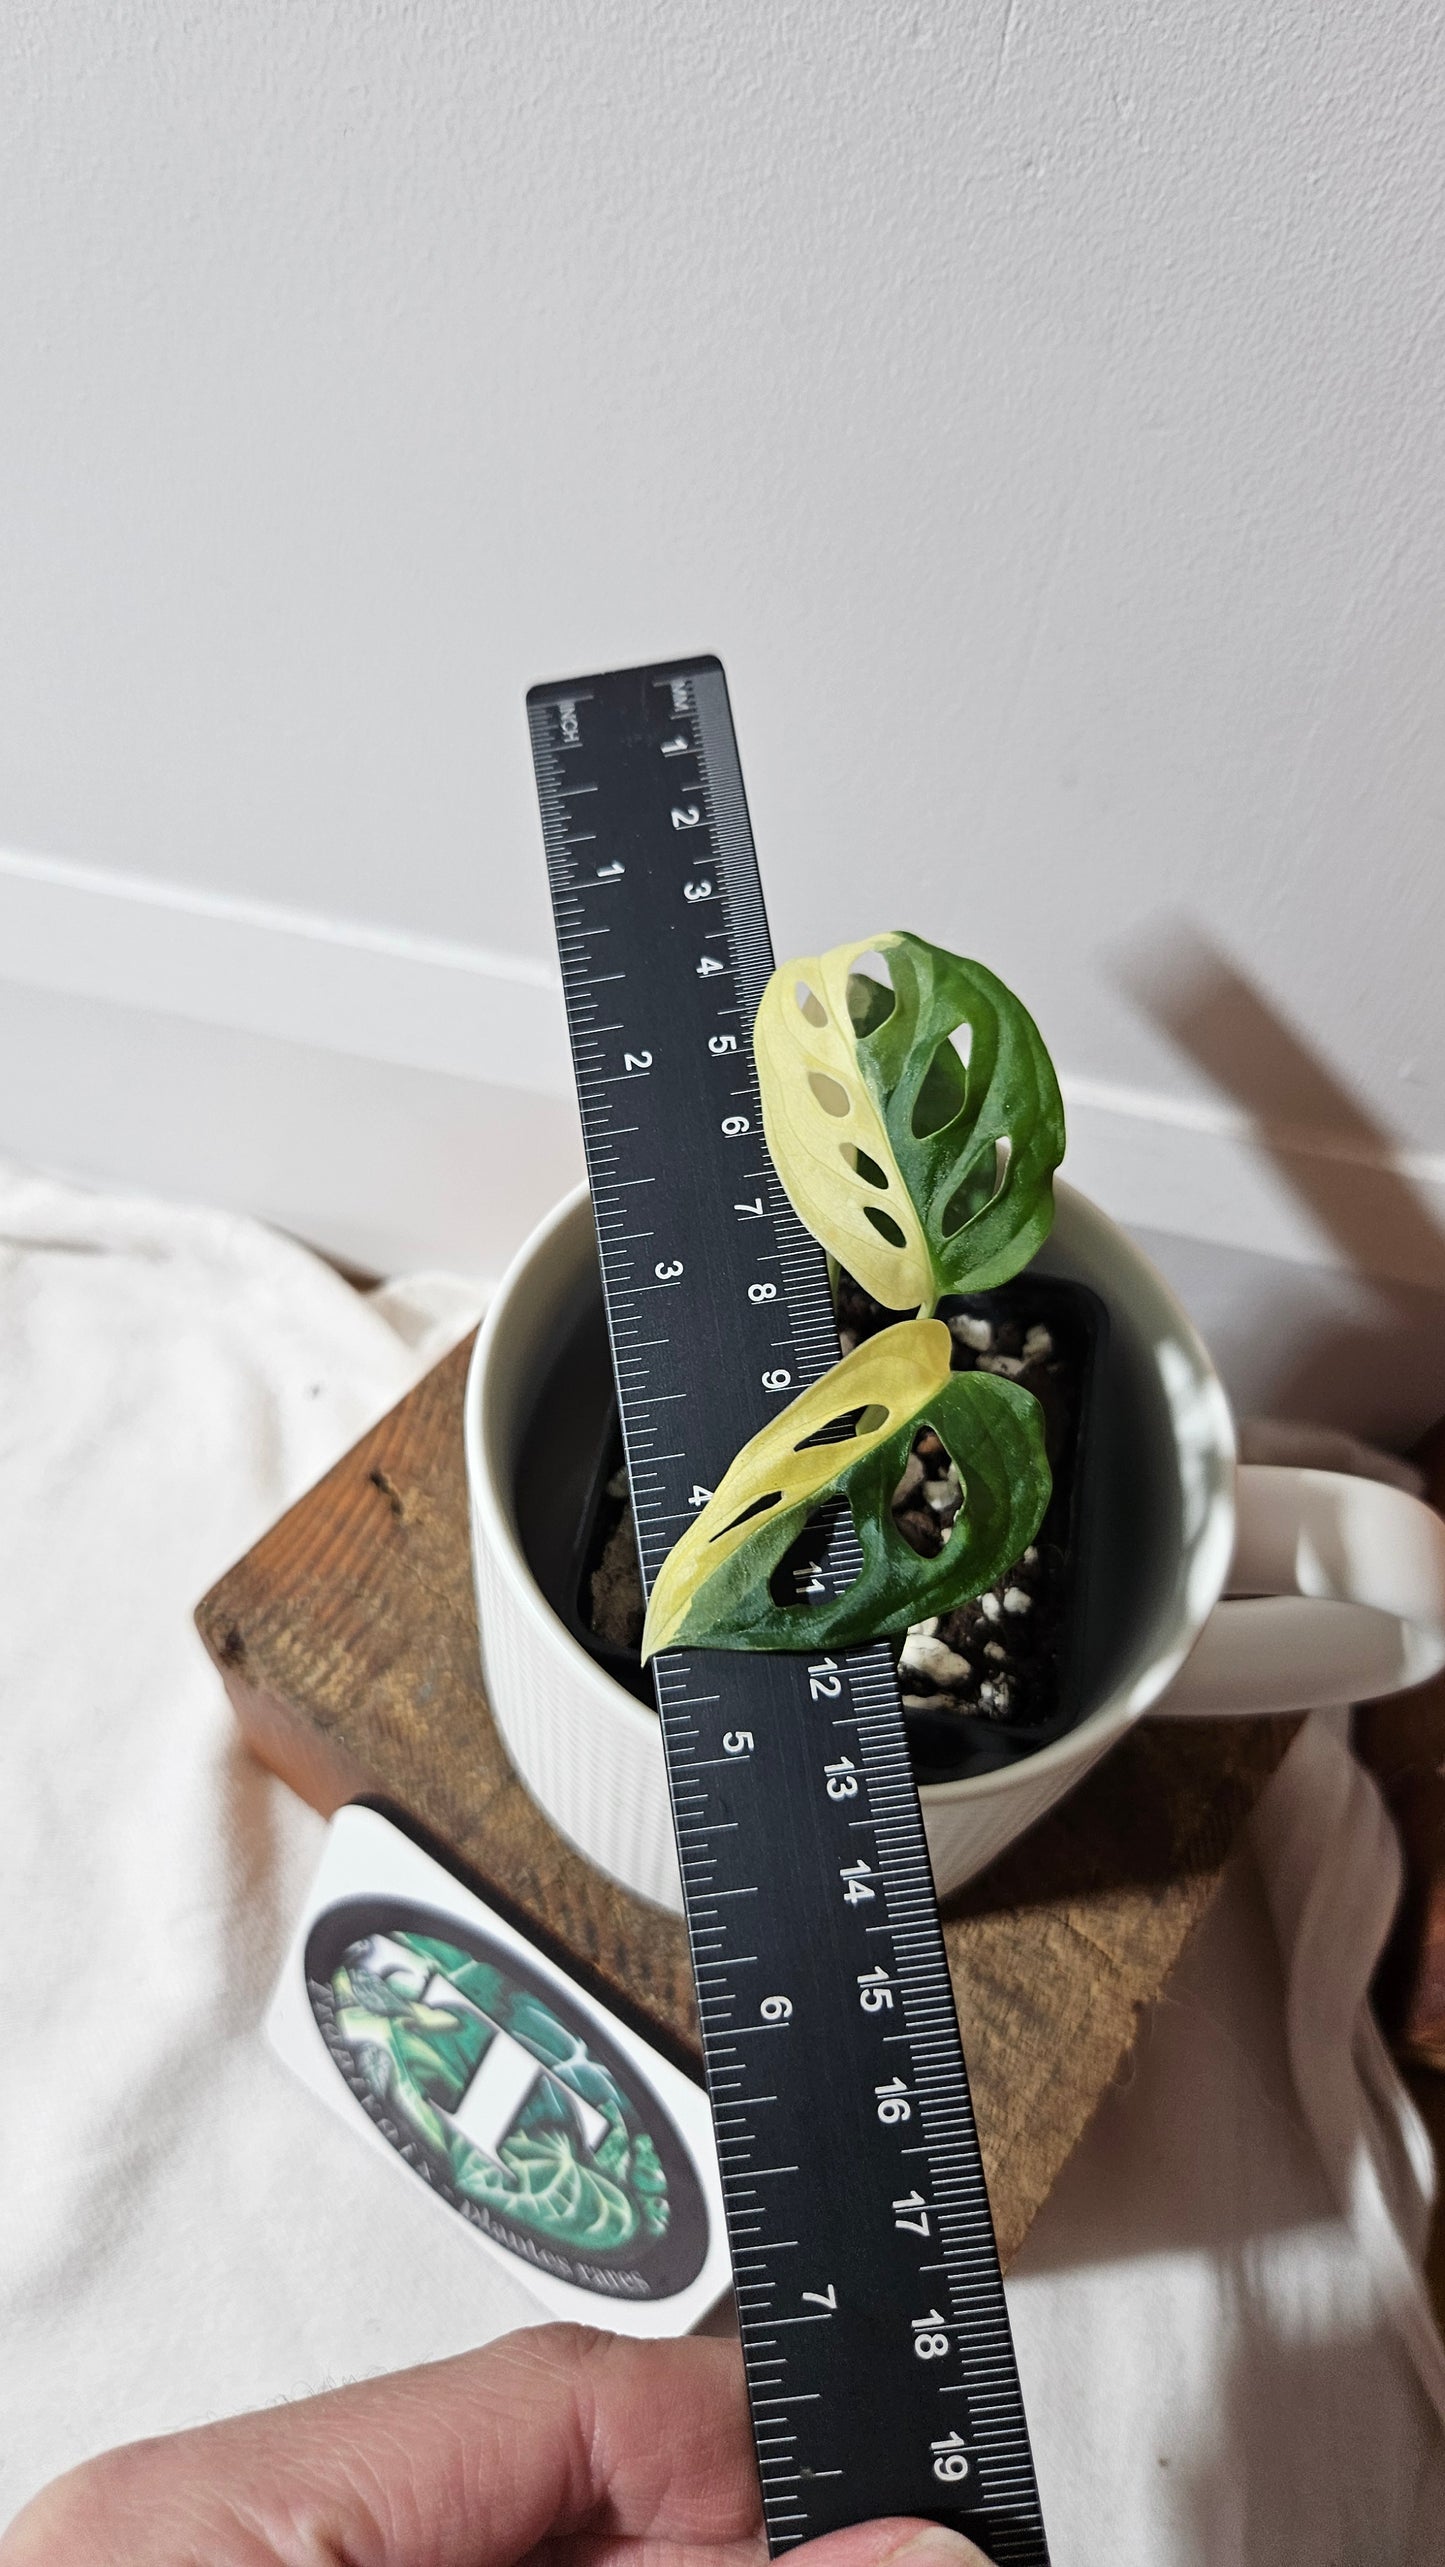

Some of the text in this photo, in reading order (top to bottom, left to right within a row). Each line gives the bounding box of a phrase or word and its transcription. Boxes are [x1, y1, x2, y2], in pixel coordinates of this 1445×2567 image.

[660, 734, 689, 754] 1
[671, 804, 700, 829] 2
[596, 859, 626, 878] 1
[684, 879, 713, 901] 3
[696, 956, 724, 976] 4
[708, 1034, 738, 1054] 5
[623, 1050, 653, 1072] 2
[720, 1115, 750, 1136] 6
[733, 1197, 764, 1216] 7
[654, 1259, 684, 1280] 3
[747, 1282, 777, 1302] 8
[761, 1368, 792, 1390] 9
[687, 1484, 715, 1507] 4
[792, 1560, 826, 1595] 11
[807, 1656, 842, 1701] 12
[722, 1729, 755, 1755] 5
[823, 1755, 859, 1801] 13
[839, 1858, 877, 1906] 14
[856, 1964, 894, 2014] 15
[759, 1994, 793, 2021] 6
[874, 2075, 911, 2125] 16
[891, 2189, 930, 2238] 17
[801, 2283, 838, 2311] 7
[910, 2308, 949, 2361] 18
[930, 2430, 970, 2483] 19
